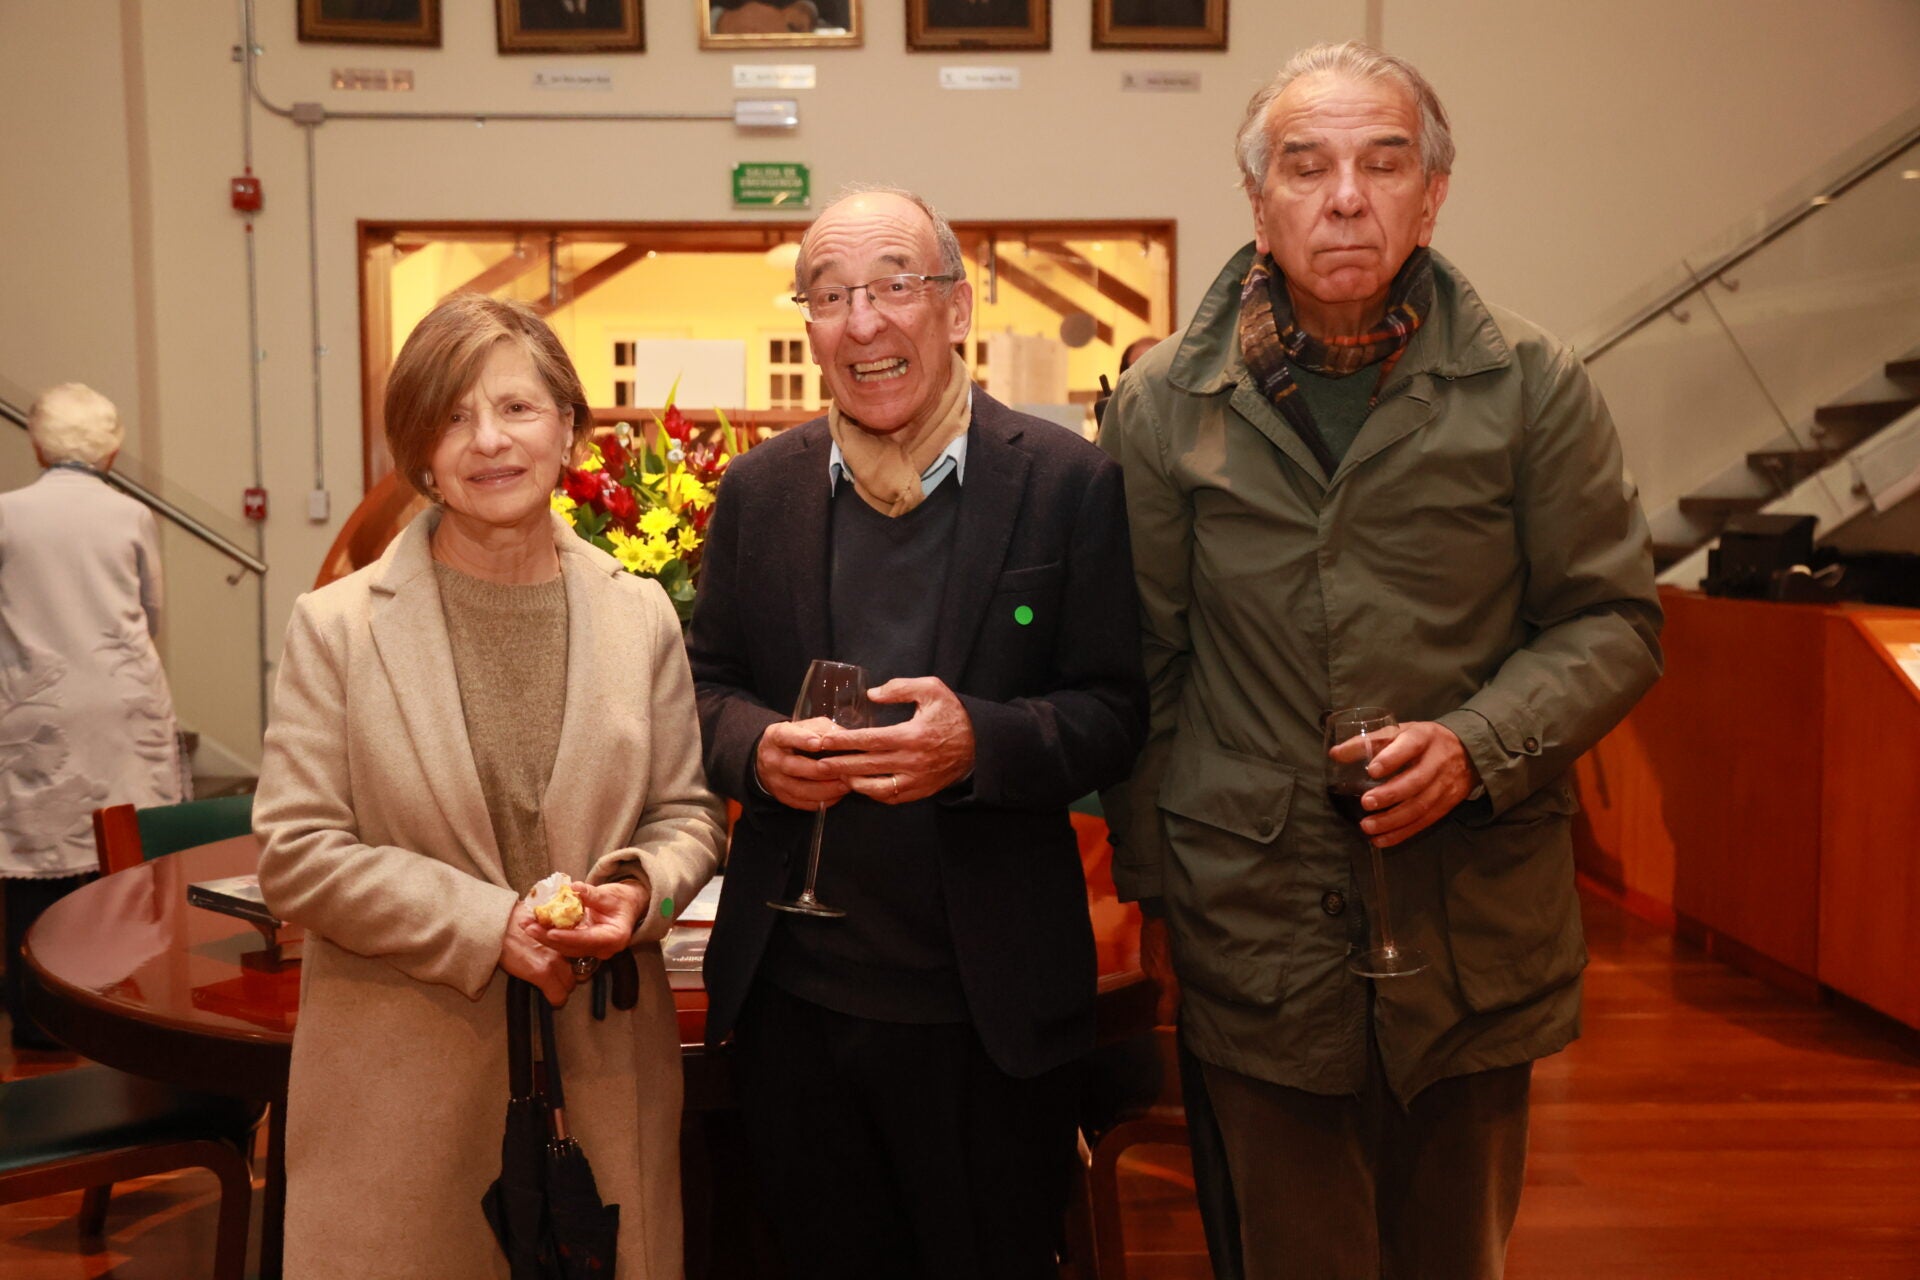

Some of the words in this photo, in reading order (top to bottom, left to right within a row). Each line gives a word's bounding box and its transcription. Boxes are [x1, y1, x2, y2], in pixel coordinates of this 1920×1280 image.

[745, 167, 782, 177] SALIDA
[783, 167, 797, 177] DE
[740, 178, 803, 188] EMERGENCIA
